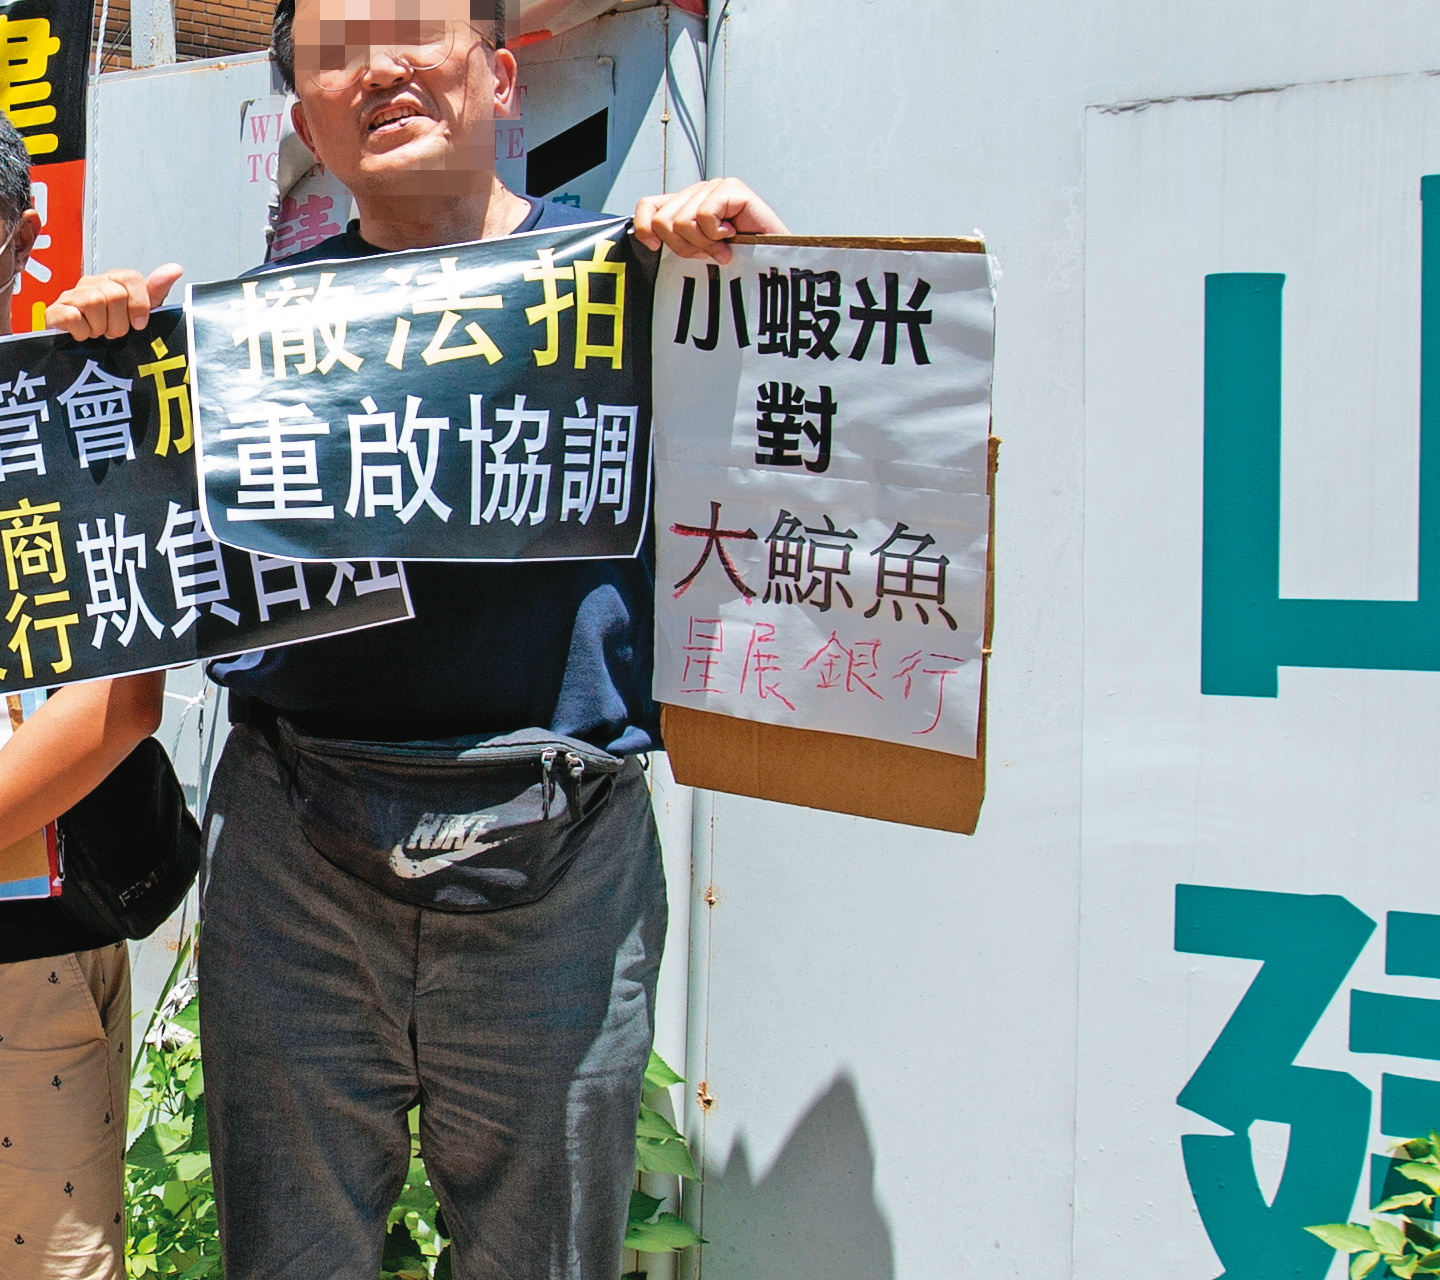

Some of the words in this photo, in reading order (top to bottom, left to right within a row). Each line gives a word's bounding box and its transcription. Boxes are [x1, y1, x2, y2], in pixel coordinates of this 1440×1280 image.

[229, 239, 627, 381] 撤法拍
[674, 266, 934, 366] 小蝦米
[226, 393, 640, 528] 重啟協調
[756, 381, 839, 474] 對
[670, 501, 959, 633] 大鯨魚
